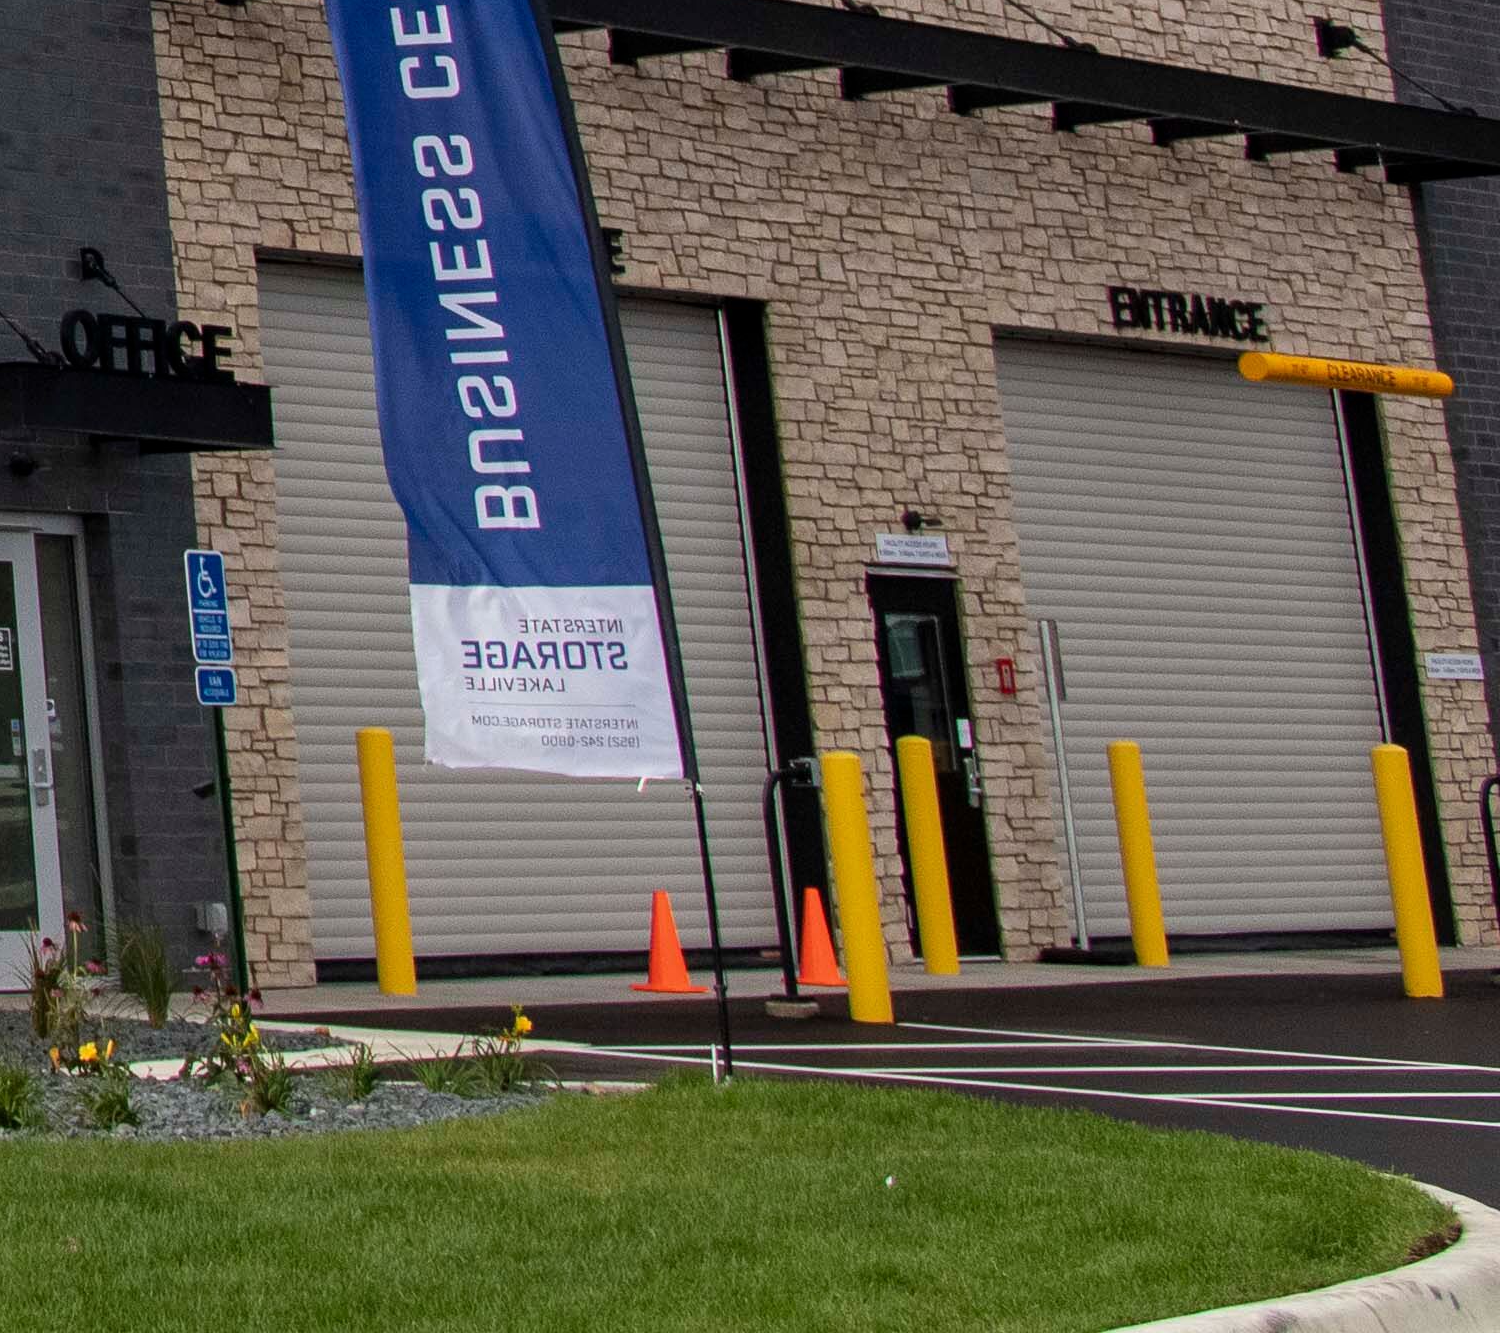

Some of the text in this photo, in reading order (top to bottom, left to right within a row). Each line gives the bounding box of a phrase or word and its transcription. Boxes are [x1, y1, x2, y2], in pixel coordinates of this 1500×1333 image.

[1106, 285, 1270, 342] ENTRANCE
[60, 309, 235, 383] OFFICE
[1326, 363, 1397, 387] CLEARANCE
